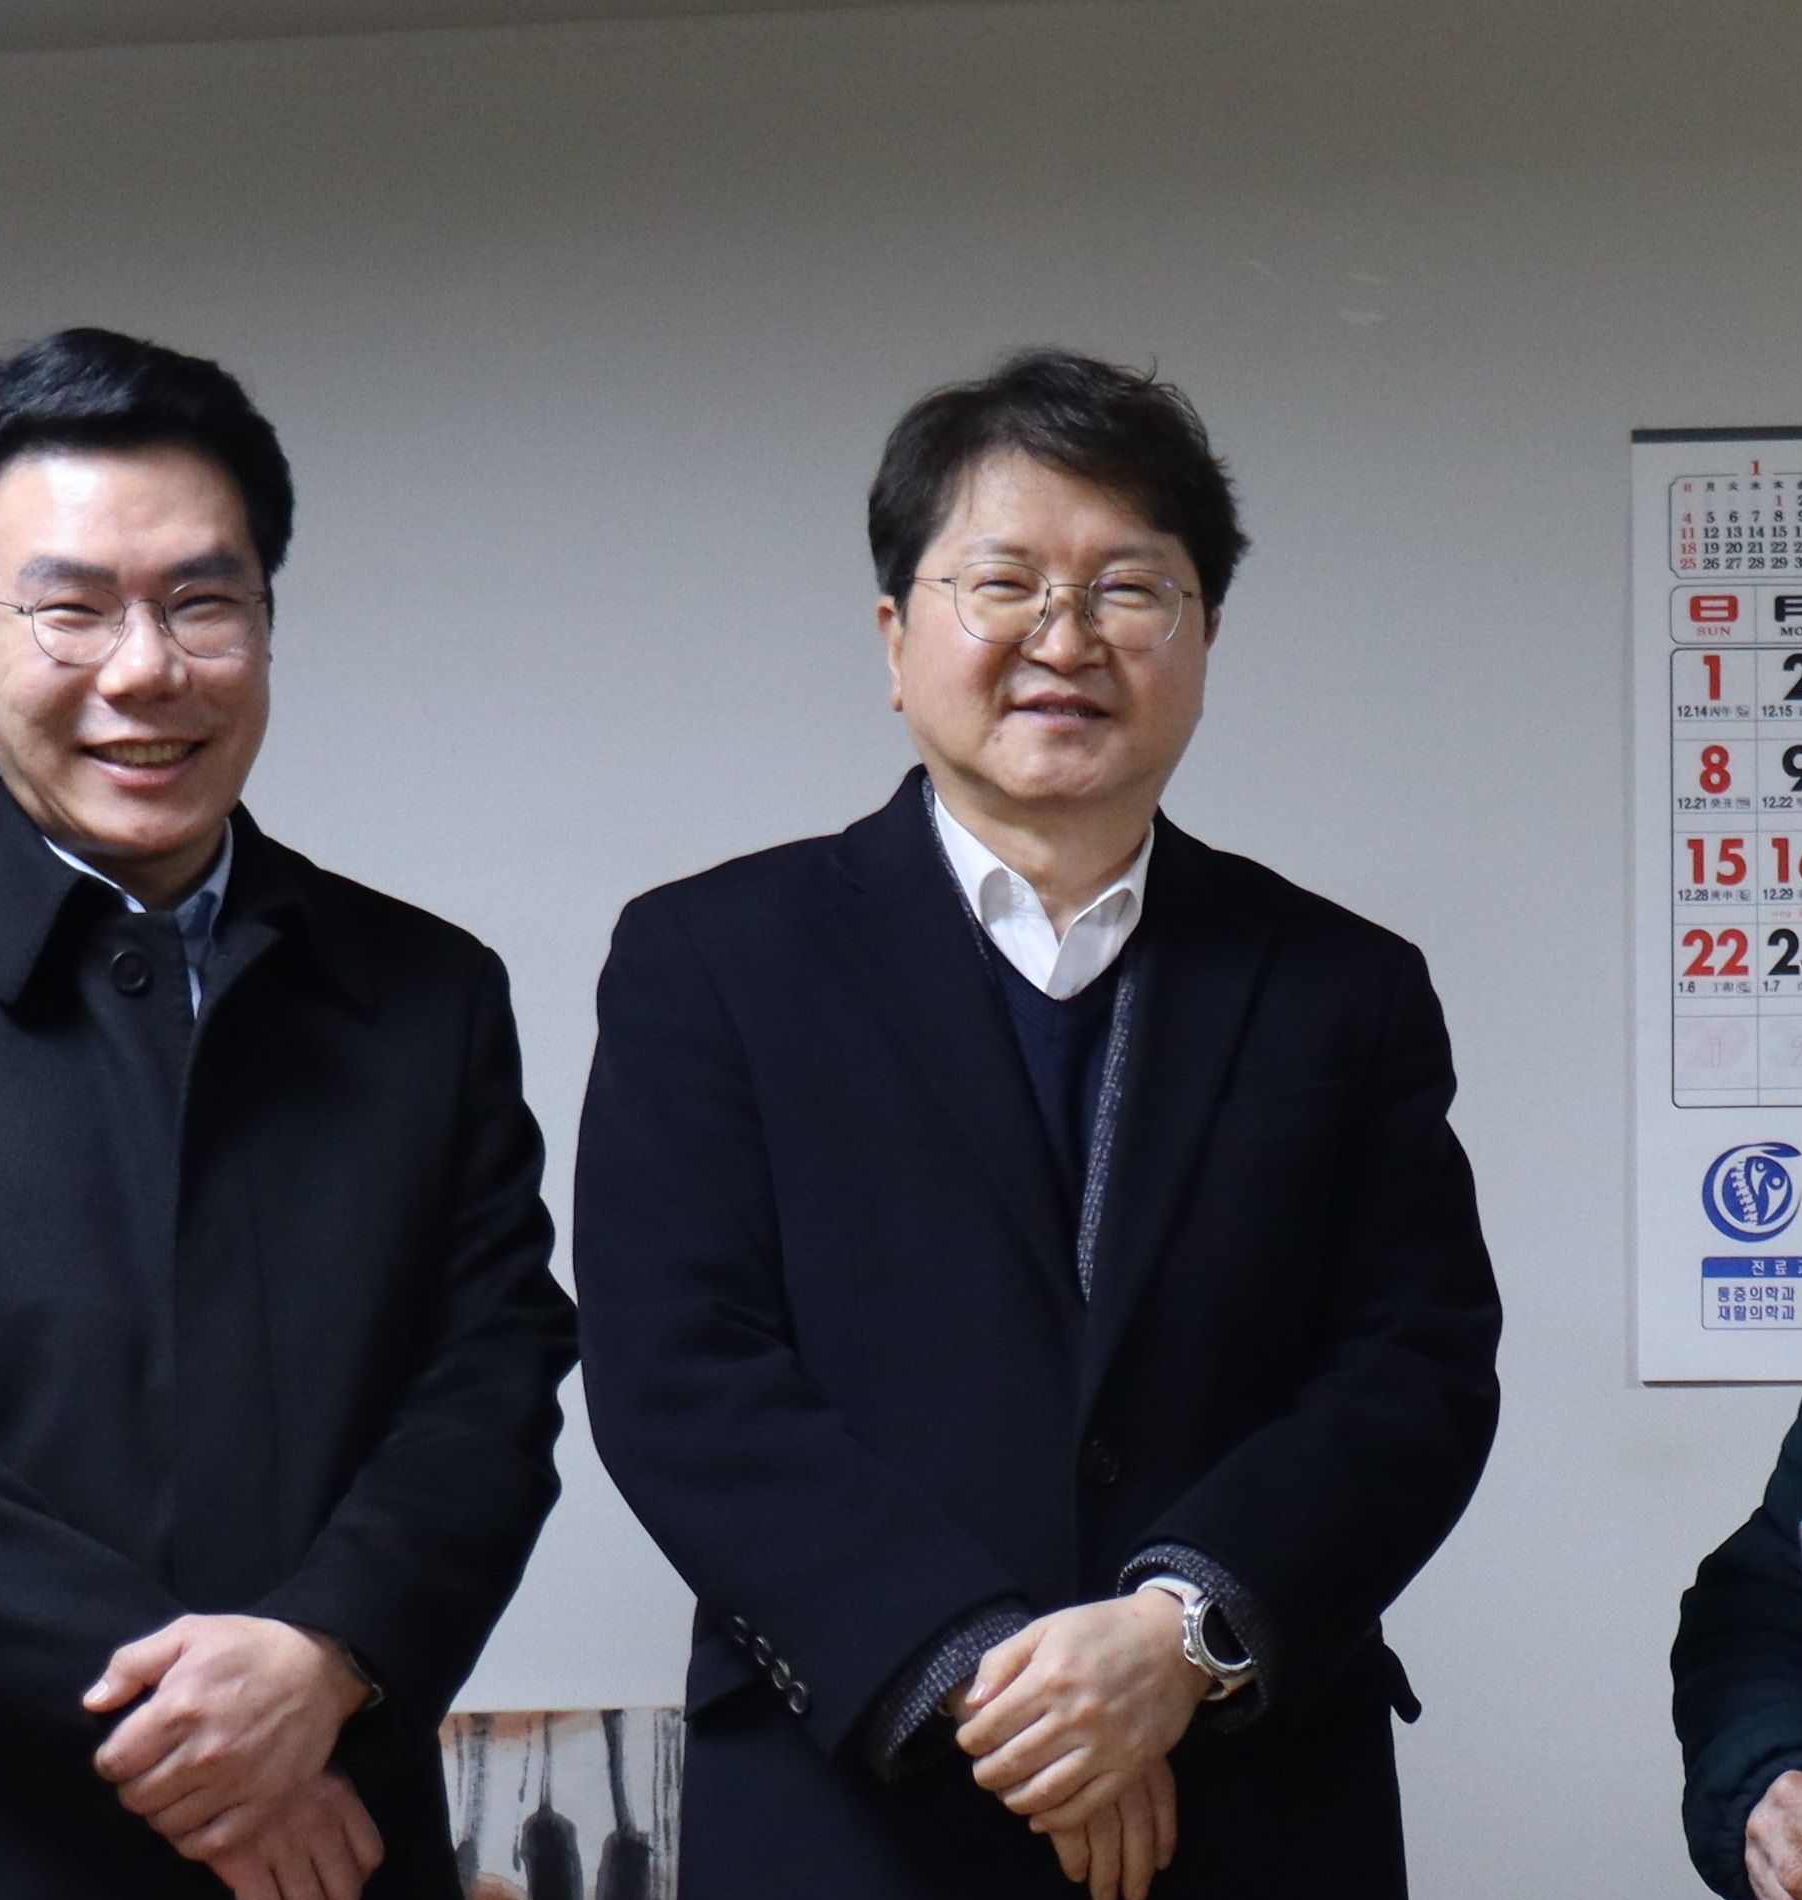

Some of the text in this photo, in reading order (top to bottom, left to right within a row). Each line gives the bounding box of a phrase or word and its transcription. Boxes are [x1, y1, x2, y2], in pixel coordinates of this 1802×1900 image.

[1752, 460, 1760, 475] 1
[1776, 495, 1782, 506] 1
[1683, 513, 1691, 523] 4
[1707, 512, 1715, 523] 5
[1729, 511, 1738, 523] 6
[1752, 511, 1760, 523] 7
[1774, 510, 1783, 522] 8
[1681, 527, 1694, 539] 11
[1704, 527, 1719, 538] 12
[1727, 526, 1742, 538] 13
[1749, 527, 1764, 538] 14
[1772, 526, 1787, 537] 15
[1681, 543, 1696, 554] 18
[1704, 543, 1719, 554] 19
[1726, 542, 1742, 553] 20
[1748, 542, 1763, 553] 21
[1771, 542, 1787, 553] 22
[1680, 558, 1696, 570] 25
[1703, 558, 1719, 569] 26
[1726, 558, 1742, 569] 27
[1748, 557, 1765, 569] 28
[1771, 557, 1788, 569] 29
[1690, 595, 1738, 622] 日
[1697, 626, 1731, 636] SUN
[1703, 655, 1721, 700] 1
[1677, 705, 1707, 717] 12.14
[1762, 705, 1792, 717] 12.15
[1700, 745, 1731, 794] 8
[1678, 797, 1706, 809] 12.21
[1762, 796, 1793, 808] 12.22
[1687, 838, 1747, 885] 15
[1678, 889, 1709, 901] 12.28
[1763, 888, 1793, 900] 12.29
[1682, 928, 1749, 976] 22
[1678, 981, 1695, 993] 1.6
[1763, 980, 1780, 992] 1.7
